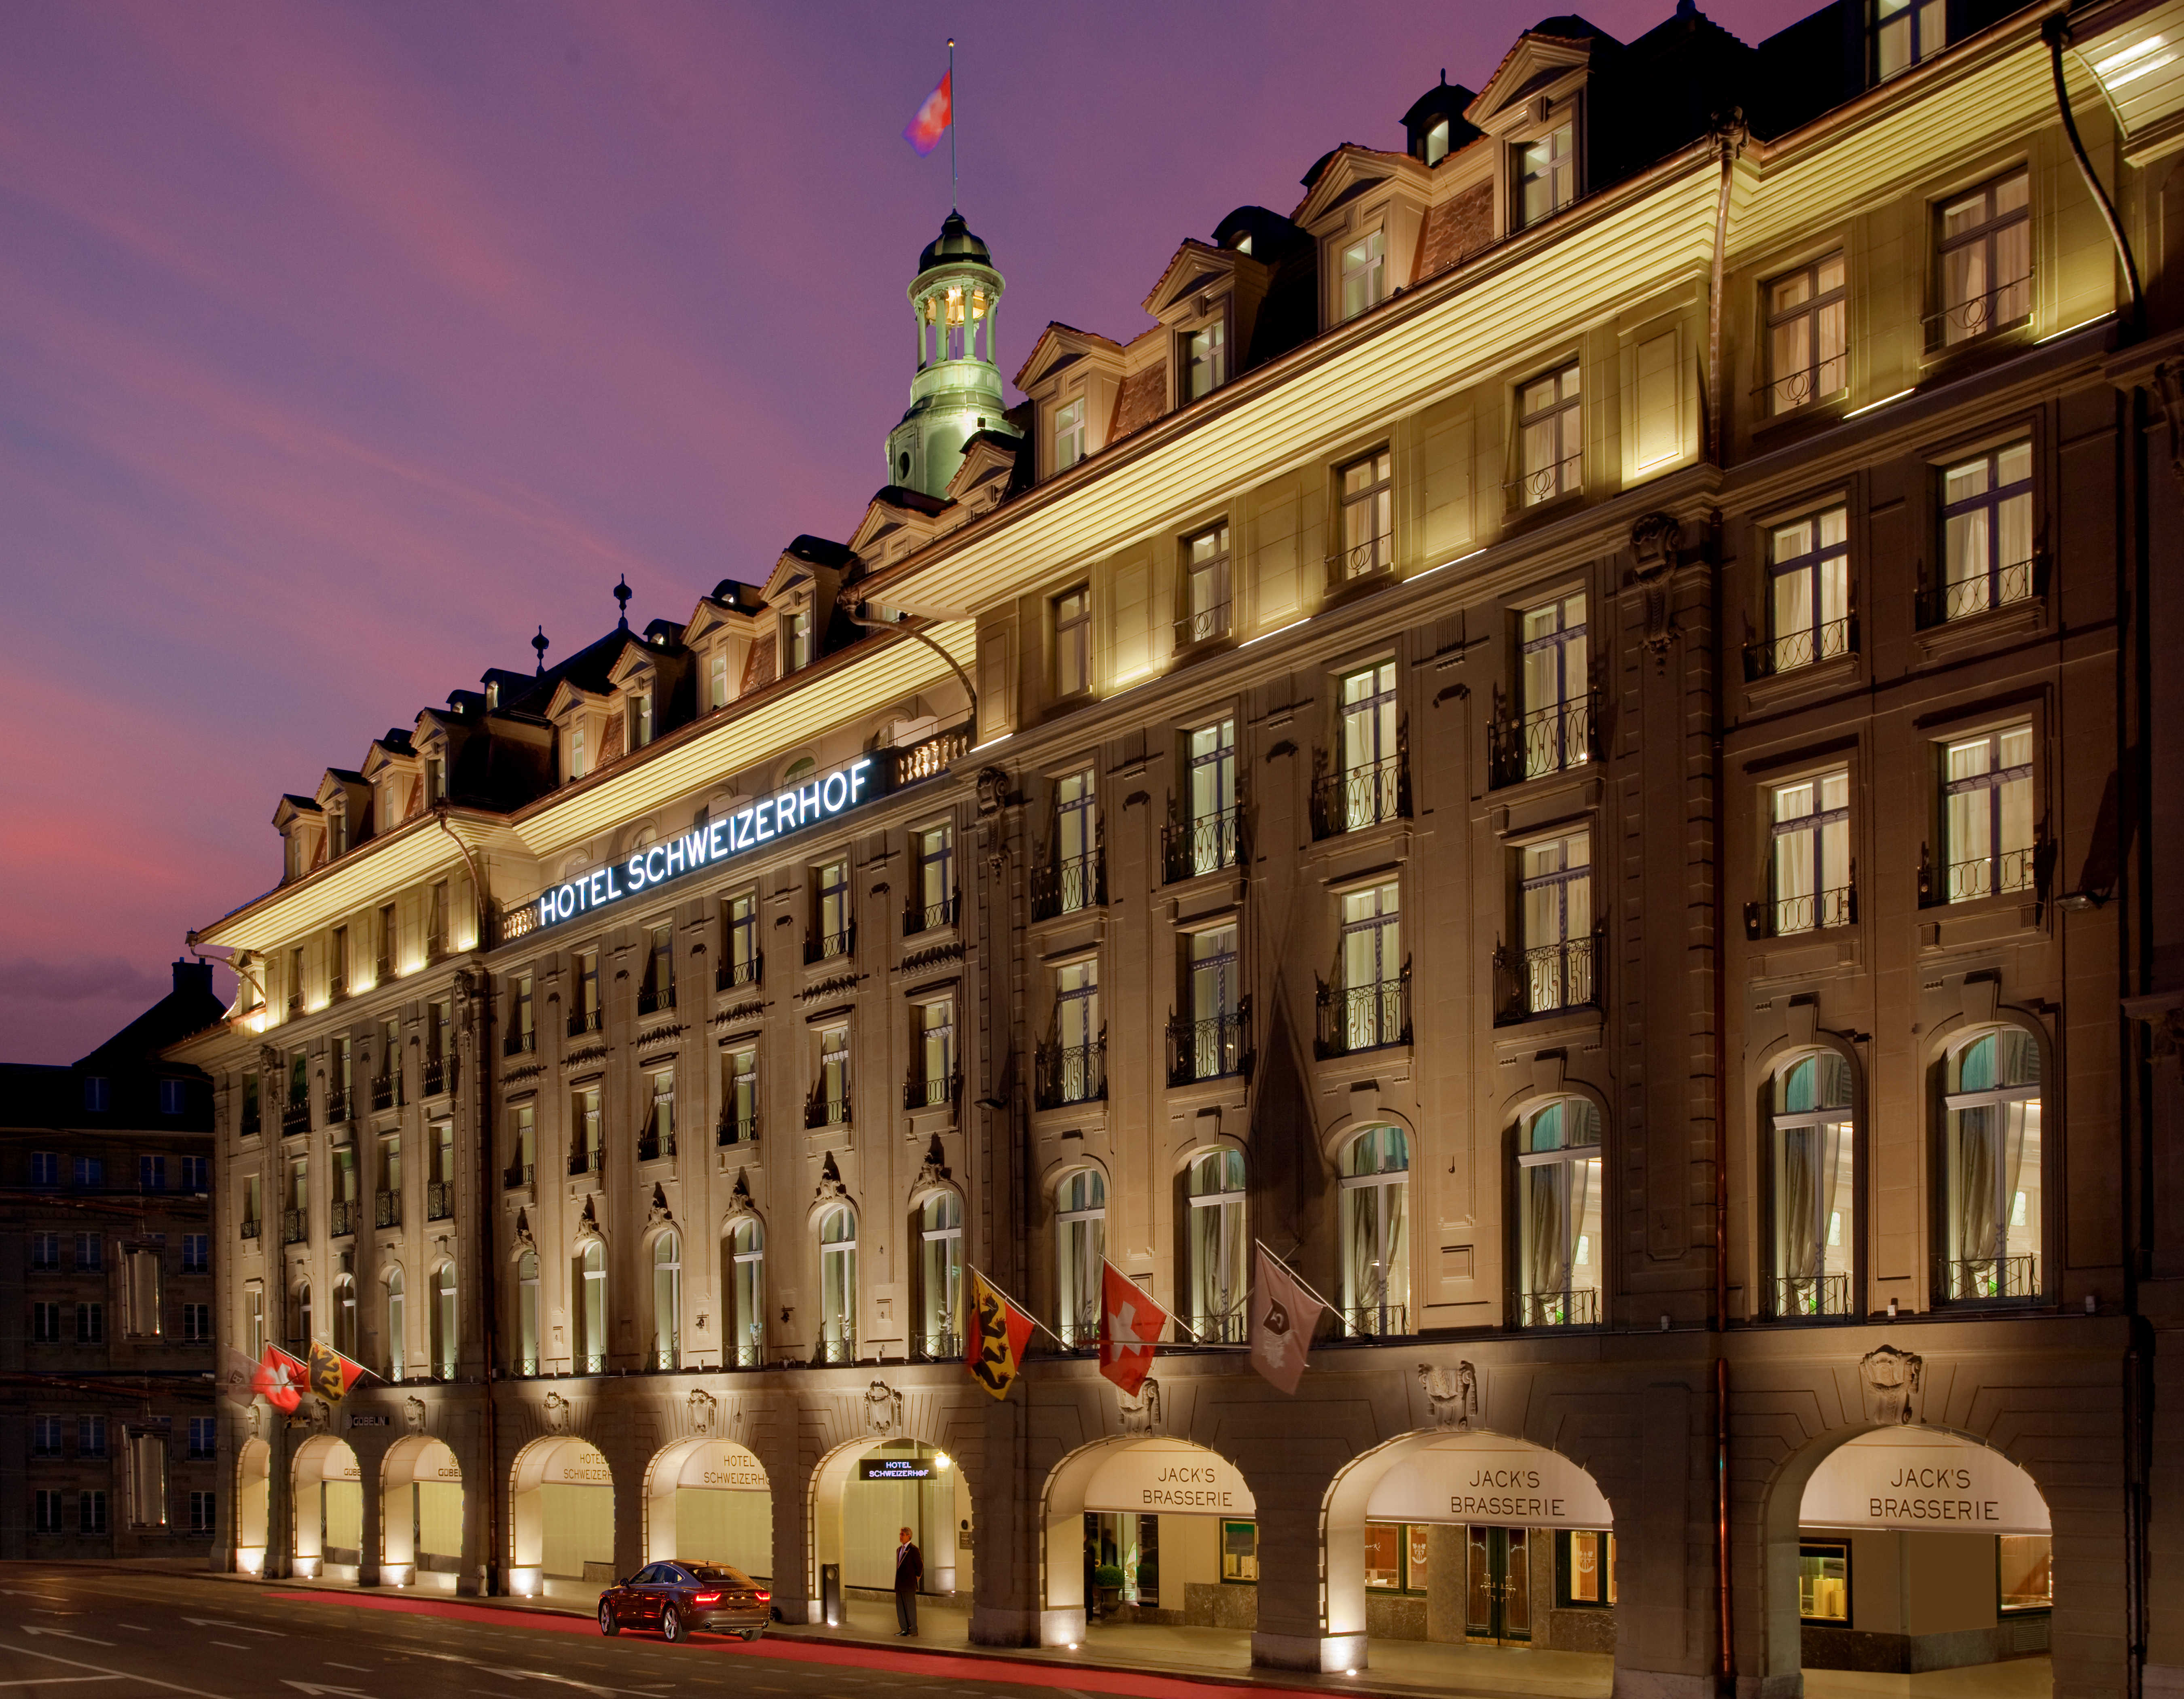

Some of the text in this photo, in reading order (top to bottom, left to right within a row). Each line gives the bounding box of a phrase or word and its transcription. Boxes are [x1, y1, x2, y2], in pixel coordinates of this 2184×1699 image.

[541, 759, 871, 926] HOTEL SCHWEIZERHOF
[580, 1453, 605, 1464] HOTEL
[724, 1455, 755, 1466] HOTEL
[1158, 1468, 1215, 1483] JACK'S
[1469, 1470, 1540, 1488] JACK'S
[1891, 1468, 1970, 1489] JACK'S
[1143, 1489, 1232, 1506] BRASSERIE
[1451, 1496, 1565, 1516] BRASSERIE
[1870, 1498, 1999, 1520] BRASSERIE
